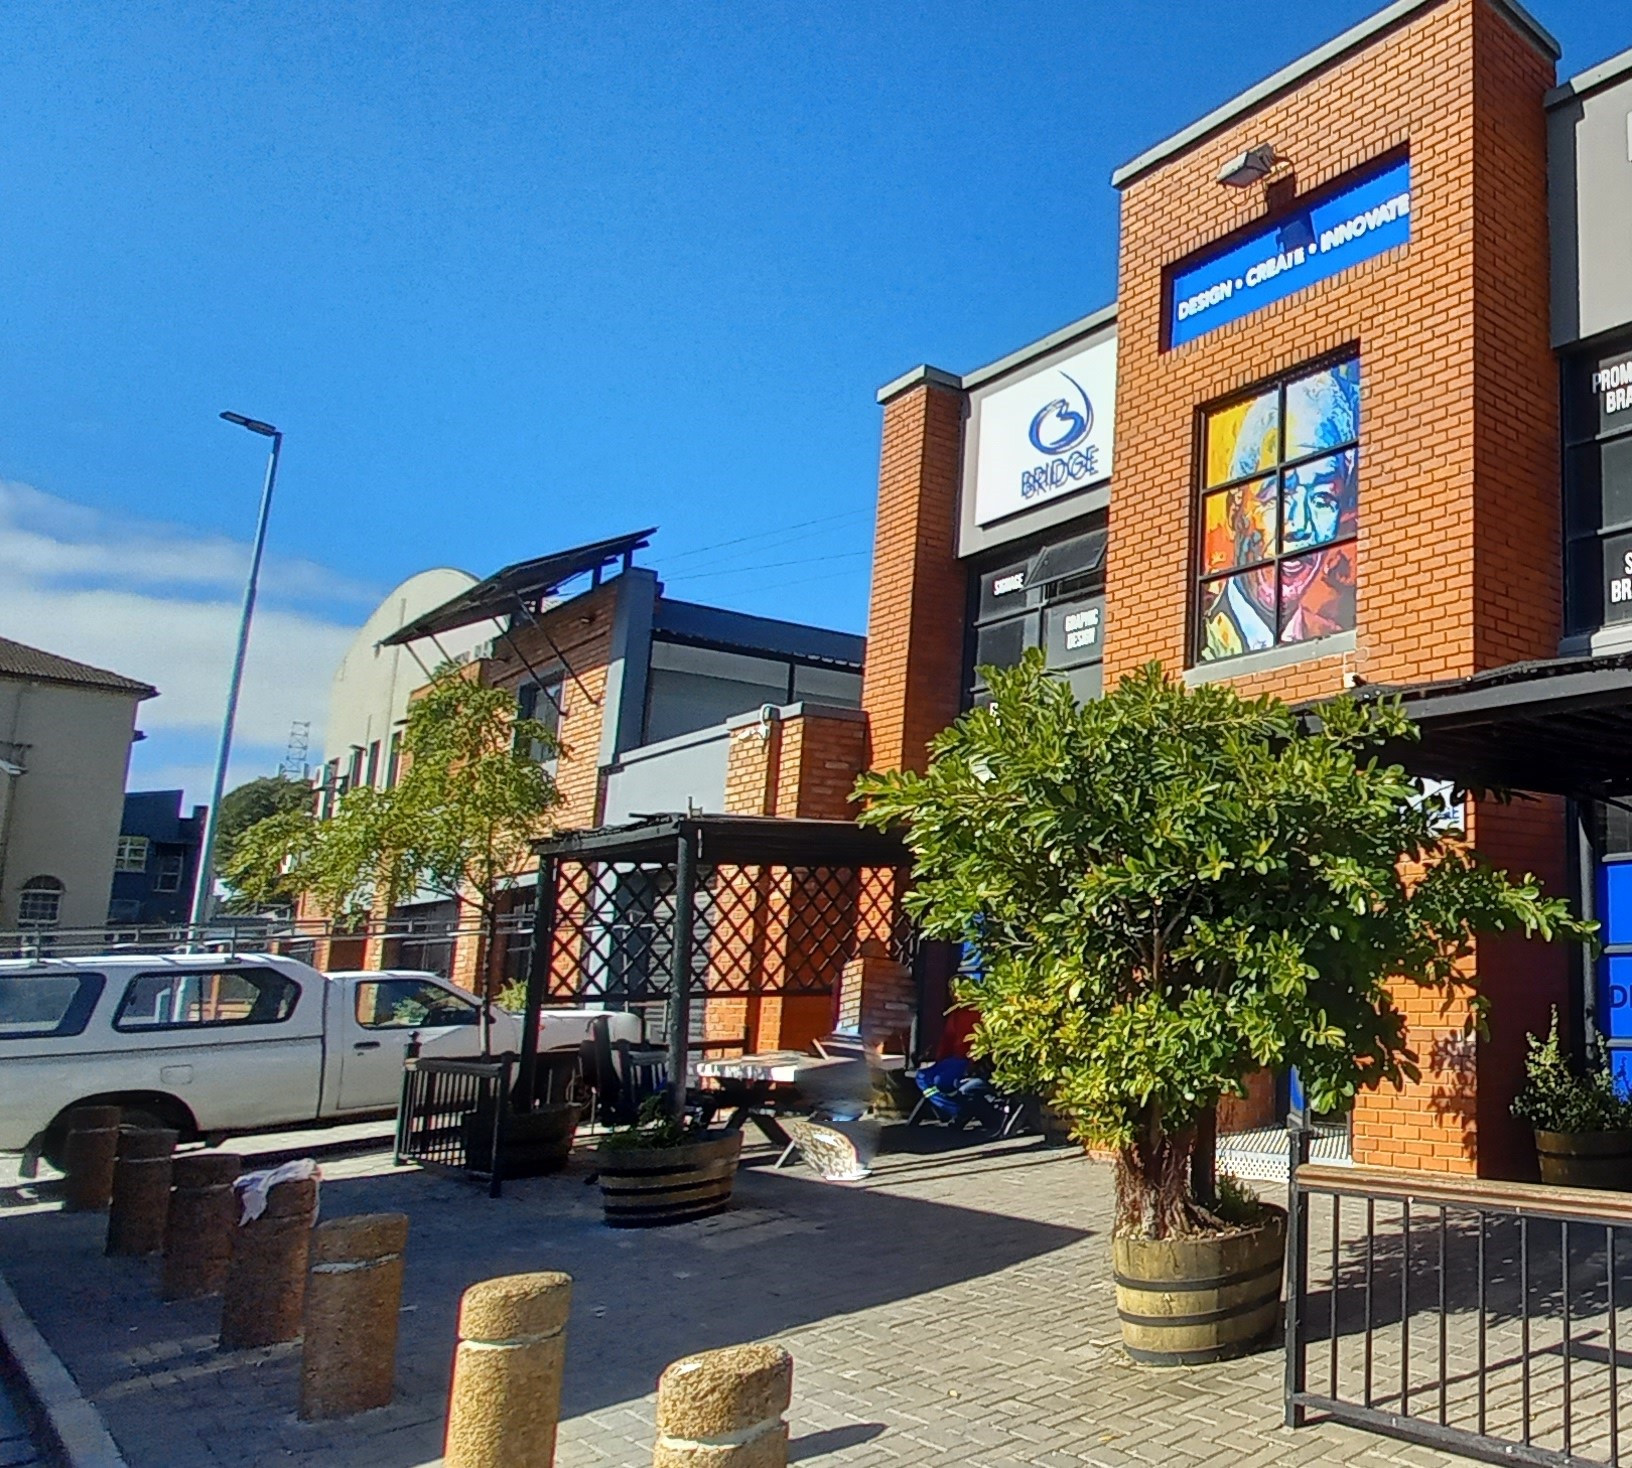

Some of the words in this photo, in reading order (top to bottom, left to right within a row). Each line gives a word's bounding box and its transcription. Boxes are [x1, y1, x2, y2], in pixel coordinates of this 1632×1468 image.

[1178, 279, 1232, 320] DESIGN
[1246, 246, 1305, 287] CREATE
[1320, 193, 1410, 253] INNOVATE
[1021, 444, 1099, 499] BRIDGE
